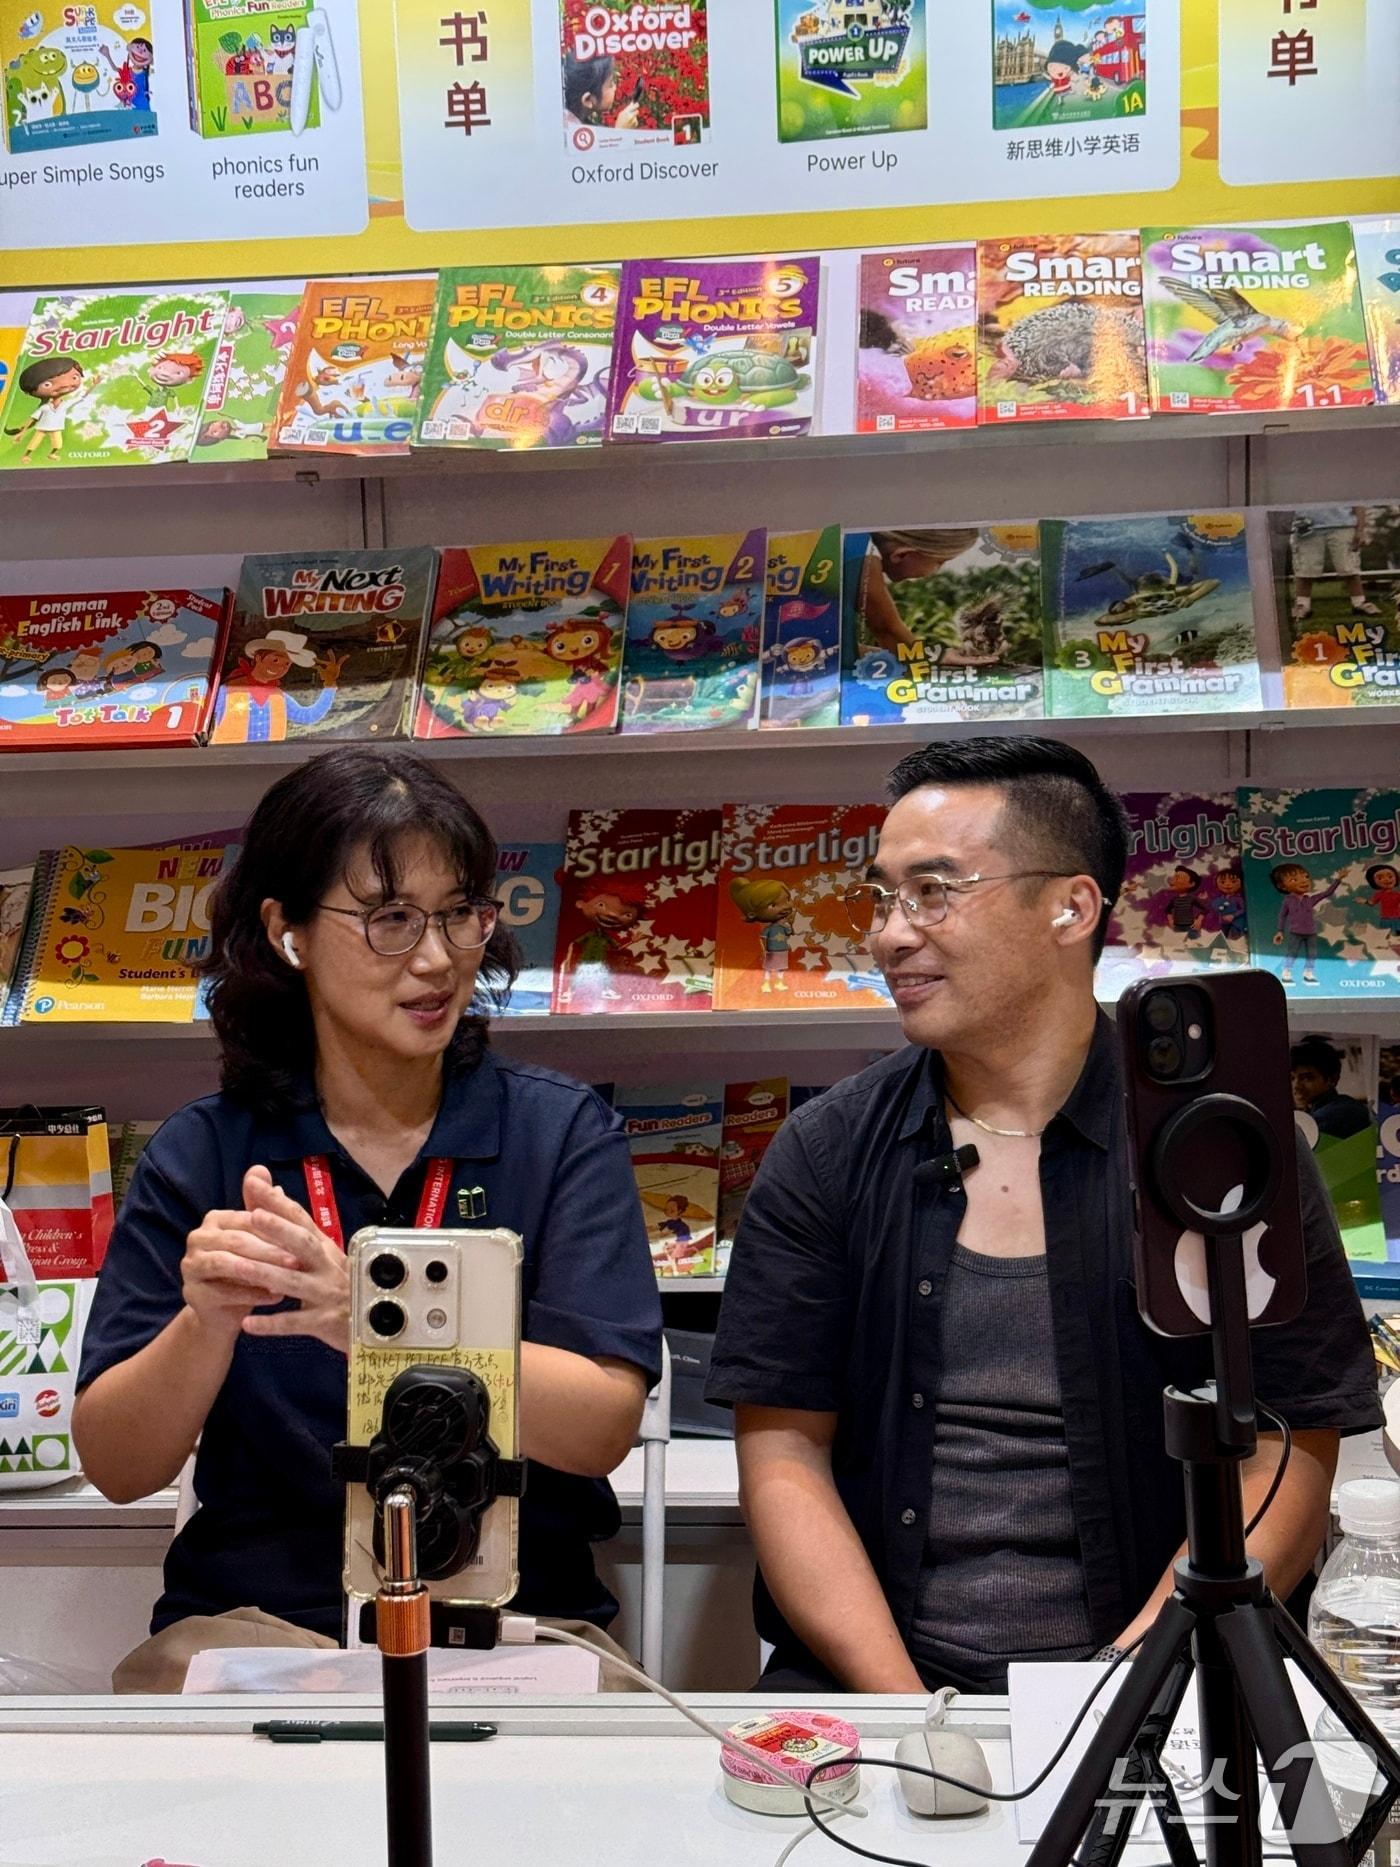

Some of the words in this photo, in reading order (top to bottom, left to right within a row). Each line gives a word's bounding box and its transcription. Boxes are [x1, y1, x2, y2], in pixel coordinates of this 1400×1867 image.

[247, 2, 269, 12] Fun
[585, 5, 691, 36] Oxford
[575, 31, 697, 60] Discover
[808, 45, 864, 64] POWER
[439, 11, 491, 136] 书单
[1123, 95, 1143, 113] 1A
[682, 124, 691, 141] 1
[1007, 133, 1140, 161] 新思维小学英语
[212, 156, 283, 179] phonics
[288, 154, 319, 173] fun
[571, 163, 633, 184] Oxford
[640, 161, 719, 181] Discover
[808, 153, 866, 172] Power
[872, 151, 897, 171] Up
[43, 164, 103, 187] Simple
[110, 162, 165, 184] Songs
[235, 179, 304, 199] readers
[1006, 251, 1141, 281] Smar
[1171, 243, 1327, 273] Smart
[640, 277, 709, 301] EFL
[775, 277, 792, 293] 5
[1024, 280, 1140, 297] READING
[1191, 274, 1310, 289] READING
[455, 282, 523, 309] EFL
[590, 288, 607, 302] 4
[322, 297, 389, 320] EFL
[448, 304, 615, 330] PHONICS
[632, 297, 803, 323] PHONICS
[30, 309, 215, 357] Starlight
[505, 331, 537, 339] Double
[538, 331, 565, 339] Letter
[704, 324, 734, 332] Double
[736, 323, 764, 331] Letter
[393, 342, 415, 351] Long
[1297, 385, 1342, 407] 1.1
[485, 399, 529, 424] dr
[143, 419, 165, 438] 2
[499, 558, 526, 573] My
[530, 552, 578, 574] First
[632, 556, 658, 570] My
[662, 548, 711, 570] First
[735, 556, 754, 579] 2
[293, 570, 320, 588] My
[320, 566, 402, 592] Next
[602, 563, 621, 585] 1
[810, 559, 833, 584] 3
[480, 571, 592, 598] Writing
[30, 599, 108, 617] Longman
[263, 585, 405, 618] WRITING
[17, 616, 82, 637] English
[84, 612, 123, 631] Link
[1336, 622, 1384, 645] My
[897, 641, 942, 661] My
[1098, 631, 1148, 653] My
[1314, 643, 1327, 661] 1
[1075, 651, 1091, 668] 3
[1113, 653, 1183, 675] First
[1352, 644, 1400, 666] Fir
[871, 661, 888, 678] 2
[910, 661, 978, 684] First
[1330, 662, 1400, 688] Gra
[886, 679, 1031, 704] Grammar
[1091, 670, 1240, 696] Grammar
[57, 706, 97, 726] Tot
[100, 703, 152, 723] Talk
[166, 706, 183, 729] 1
[956, 704, 980, 713] BOOK
[1251, 809, 1400, 859] Starlig
[119, 967, 186, 979] Student's
[1340, 980, 1386, 988] OXFORD
[795, 990, 837, 998] OXFORD
[58, 1000, 104, 1011] Pearson
[627, 1119, 659, 1133] Fun
[662, 1113, 712, 1129] Readers
[727, 1108, 777, 1125] Readers
[53, 1255, 87, 1269] Group
